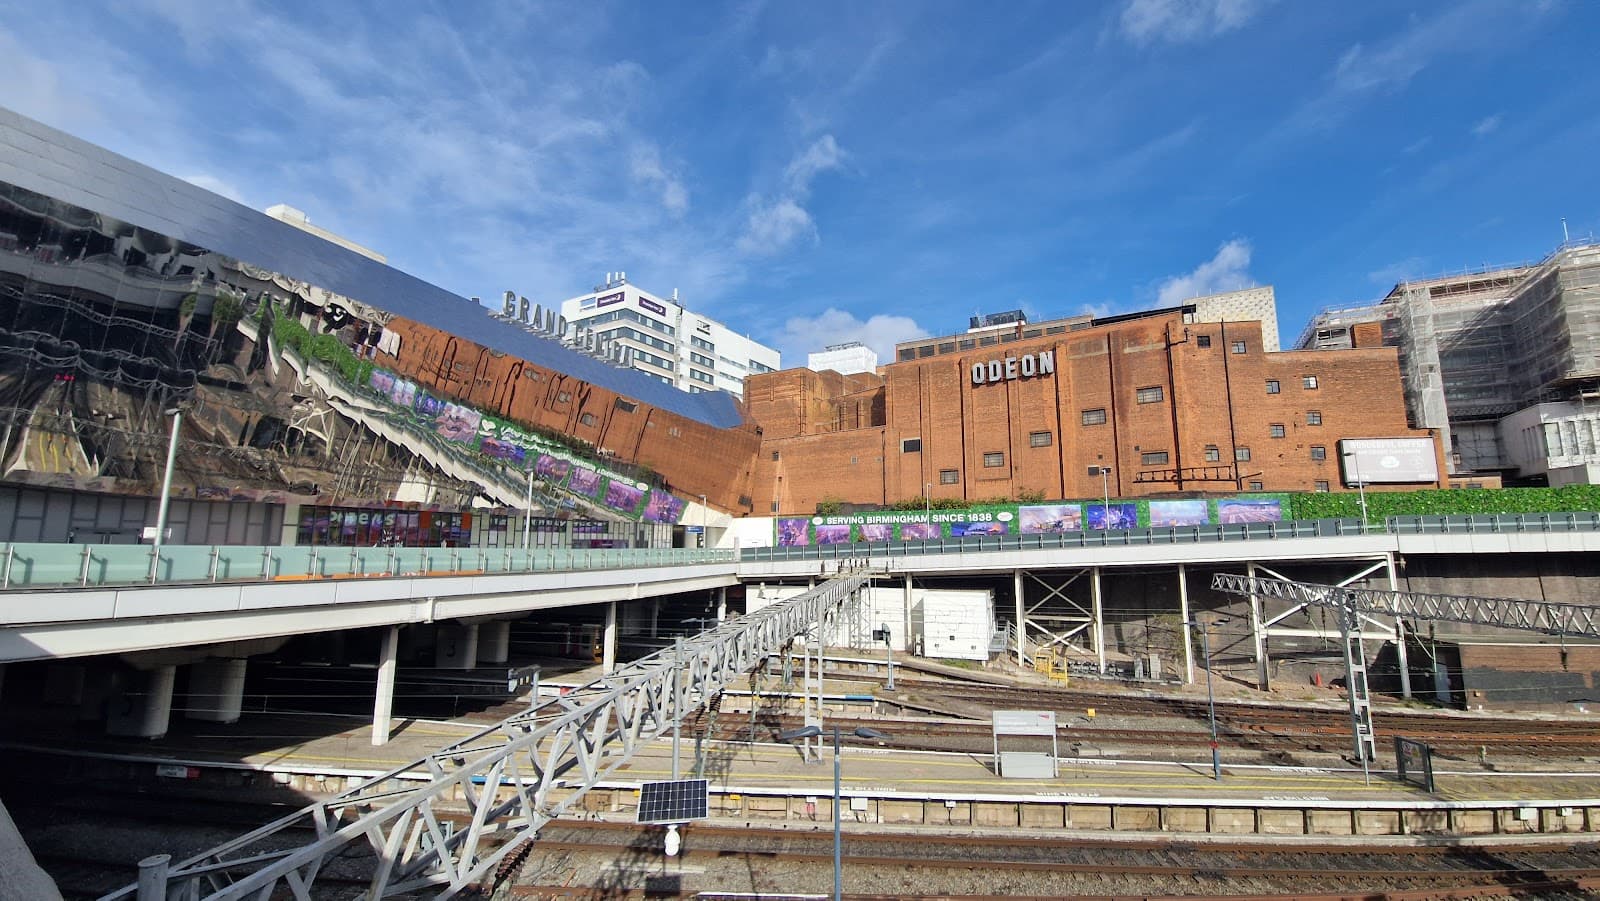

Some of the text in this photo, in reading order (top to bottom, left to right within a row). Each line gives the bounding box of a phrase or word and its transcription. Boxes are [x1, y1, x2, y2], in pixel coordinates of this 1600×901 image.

[503, 290, 567, 337] GRAND
[972, 350, 1054, 384] ODEON
[826, 512, 992, 525] SERVING BIRMINGHAM SINCE 1838
